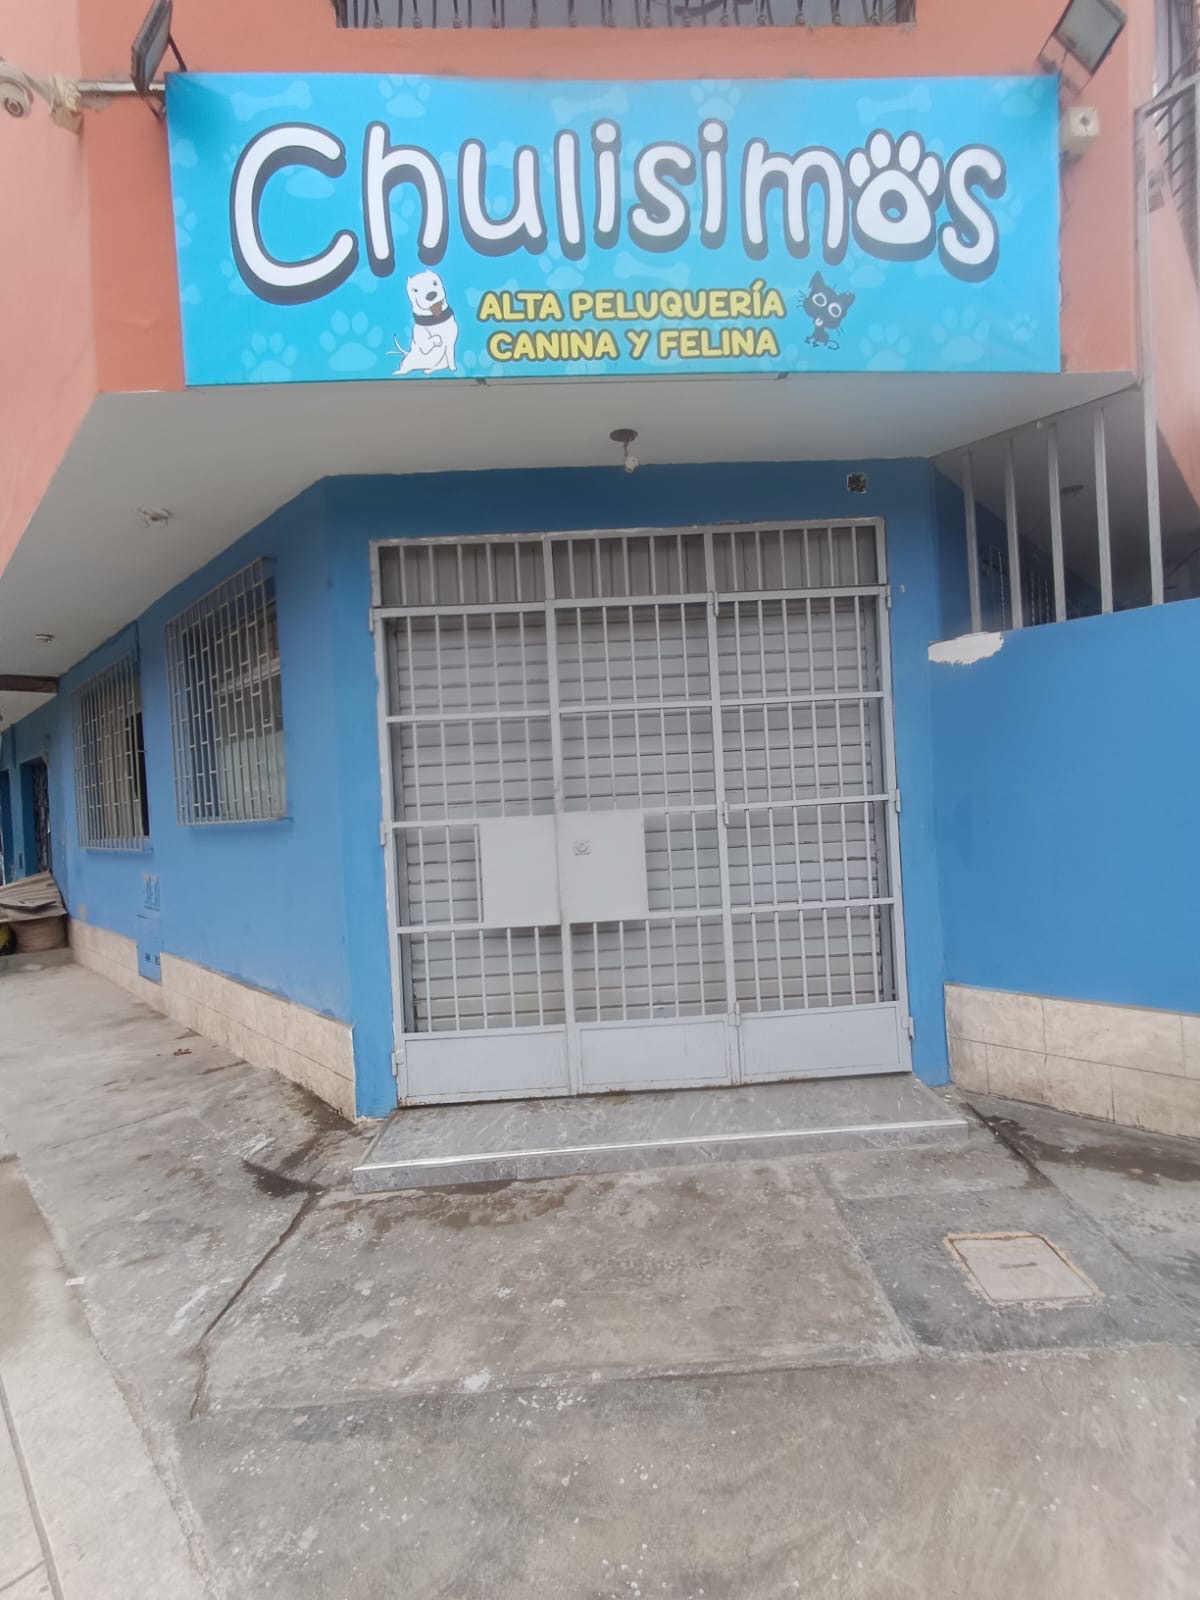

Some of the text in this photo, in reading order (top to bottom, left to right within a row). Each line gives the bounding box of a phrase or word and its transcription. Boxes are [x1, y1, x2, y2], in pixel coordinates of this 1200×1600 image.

[231, 120, 1005, 303] Chulisimos
[478, 279, 785, 320] ALTA PELUQUERÍA
[488, 328, 779, 360] CANINA Y FELINA
